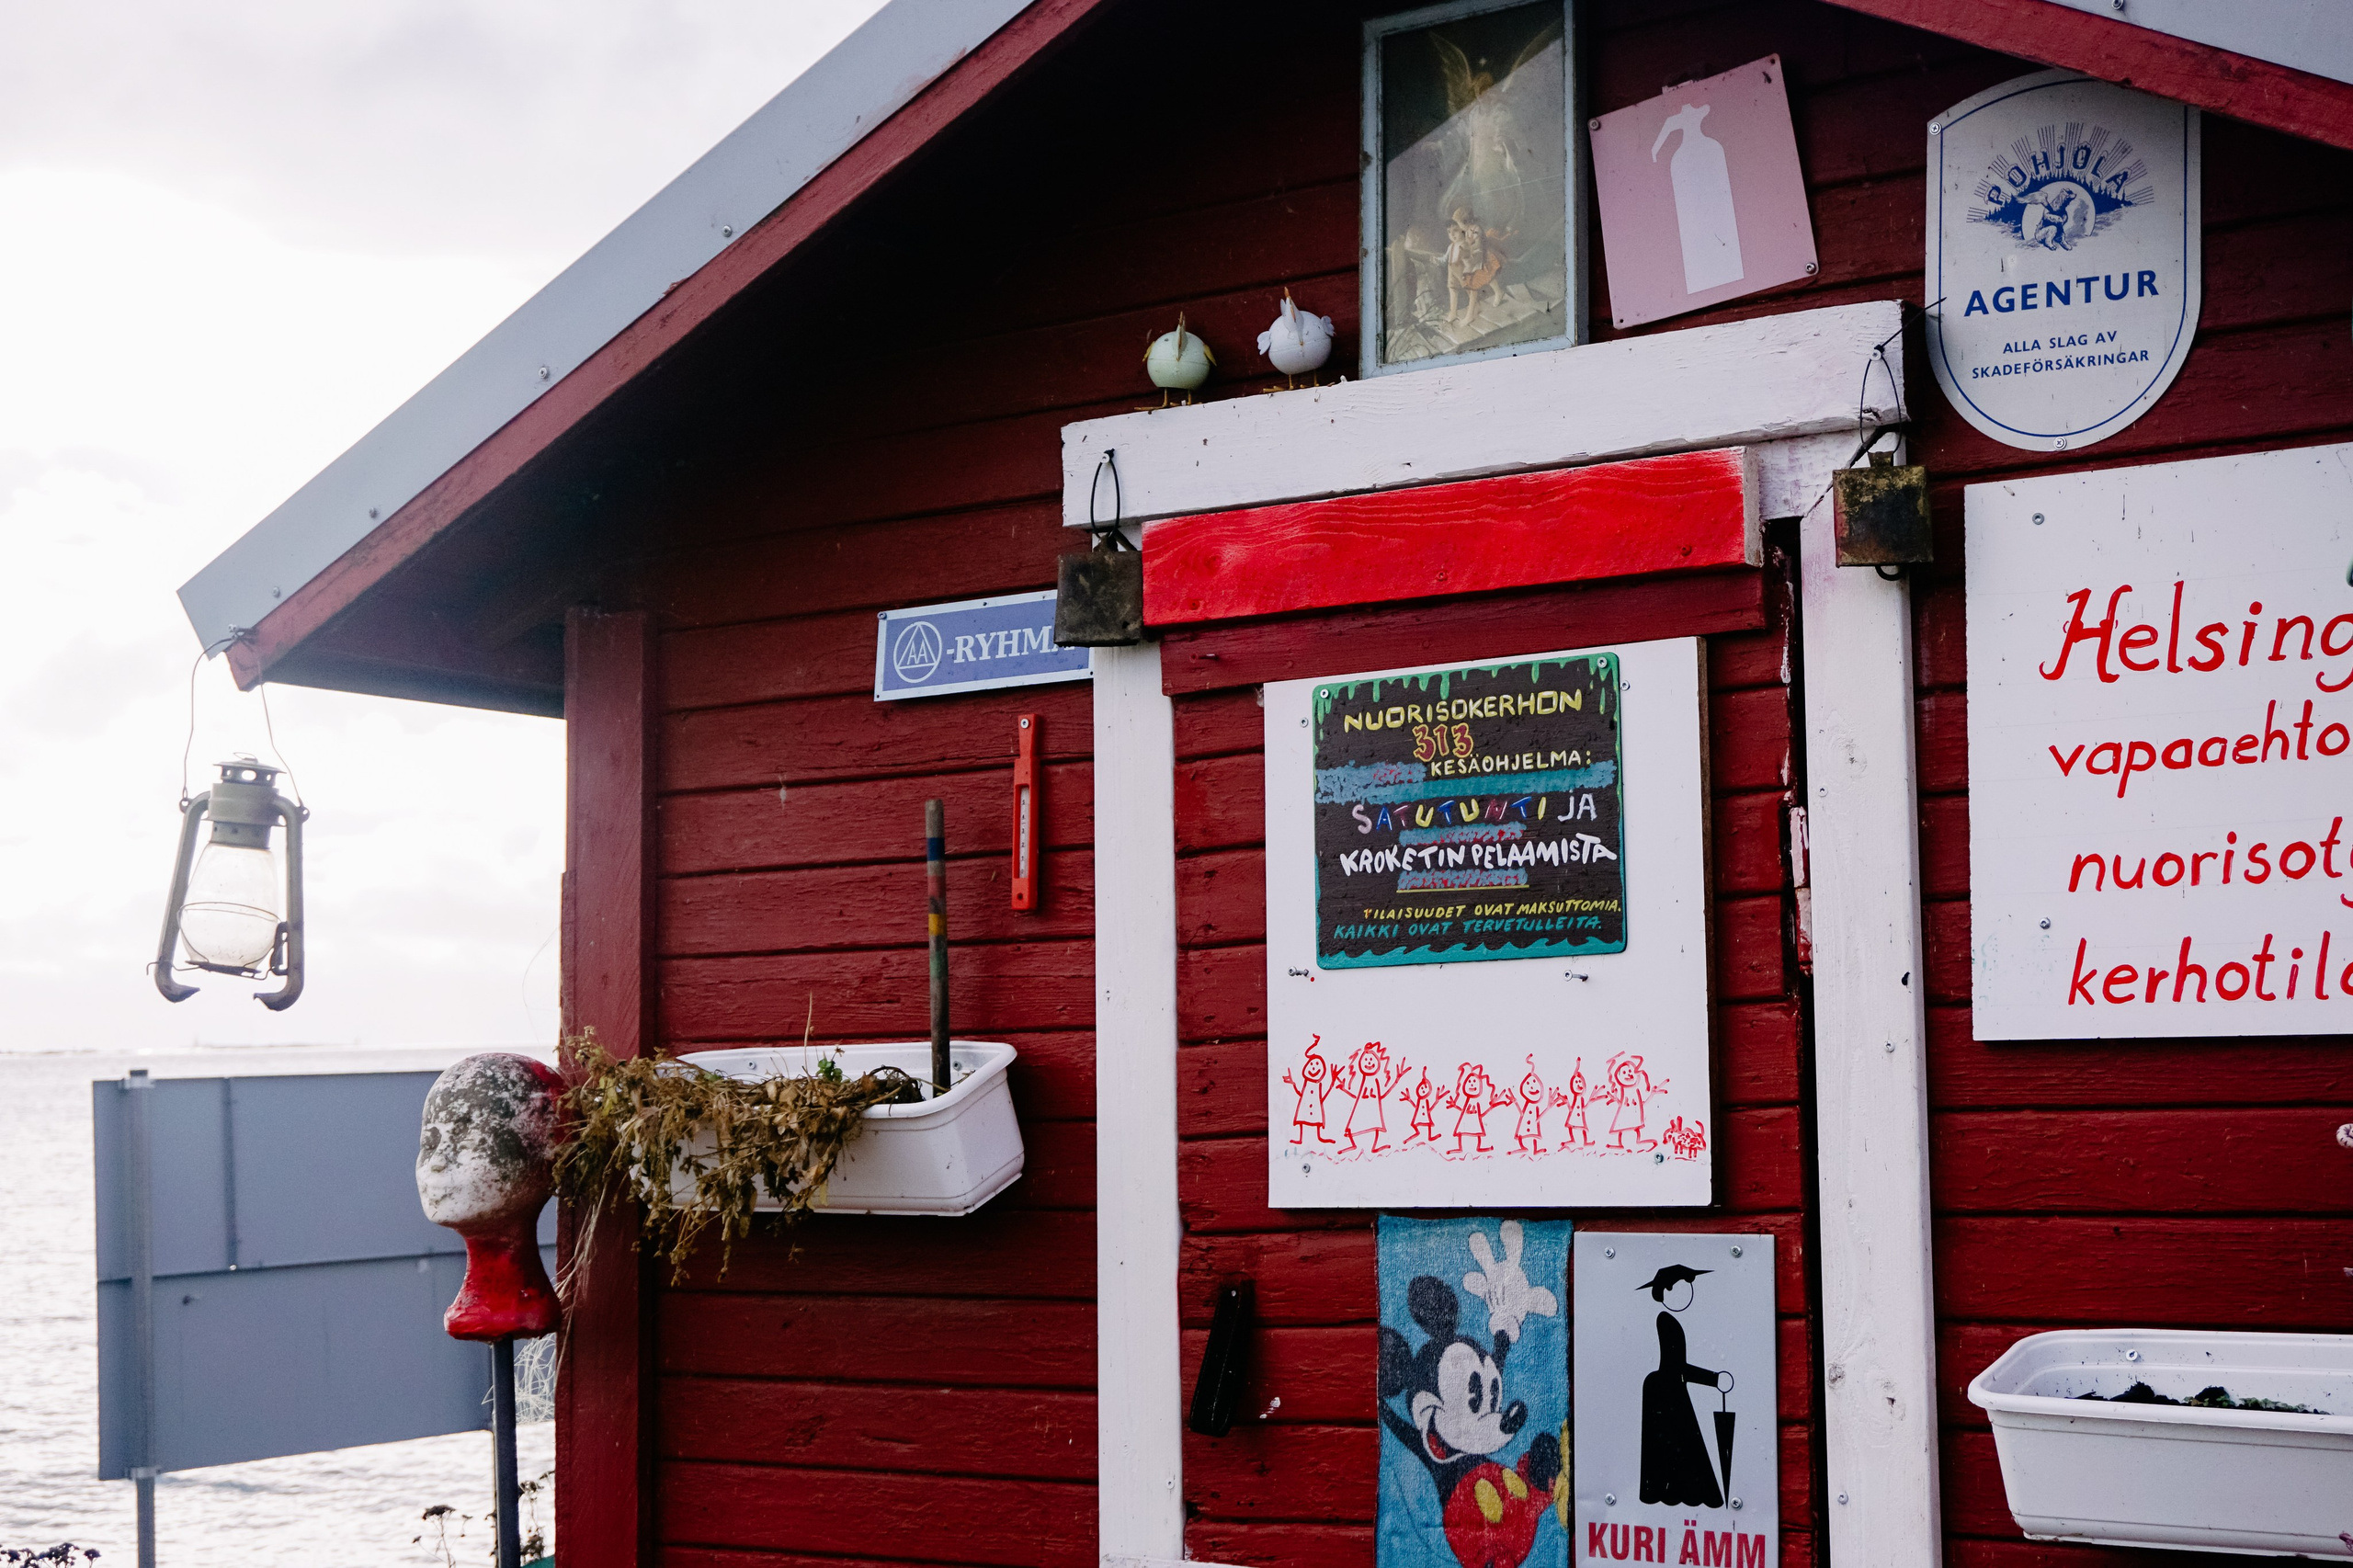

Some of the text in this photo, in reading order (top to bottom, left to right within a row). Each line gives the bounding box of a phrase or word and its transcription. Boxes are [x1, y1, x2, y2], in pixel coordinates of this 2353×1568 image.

[1984, 141, 2132, 206] POHJOLA
[1963, 269, 2159, 317] AGENTUR
[2003, 331, 2118, 354] ALLA SLAG AV
[1972, 349, 2150, 380] SKADEFÖRSÄKRINGAR
[947, 625, 1075, 664] -RYHM
[1344, 688, 1583, 733] NUORISOKERHON
[1413, 722, 1474, 762] 313
[1431, 749, 1592, 777] KESÄOHJELMA:
[2049, 699, 2351, 799] vapaaehto
[1352, 791, 1597, 834] SATUTUNTI JA
[1340, 833, 1618, 876] KROKETIN PELAAMISTA
[2068, 816, 2353, 908] nuorisot
[1334, 915, 1602, 939] KAIKKI OVAT TERVETULLEITA.
[1363, 899, 1621, 920] TILAISUUDET OVAT MAKSUTTOMIA.
[1588, 1519, 1766, 1568] KURI ÄMM
